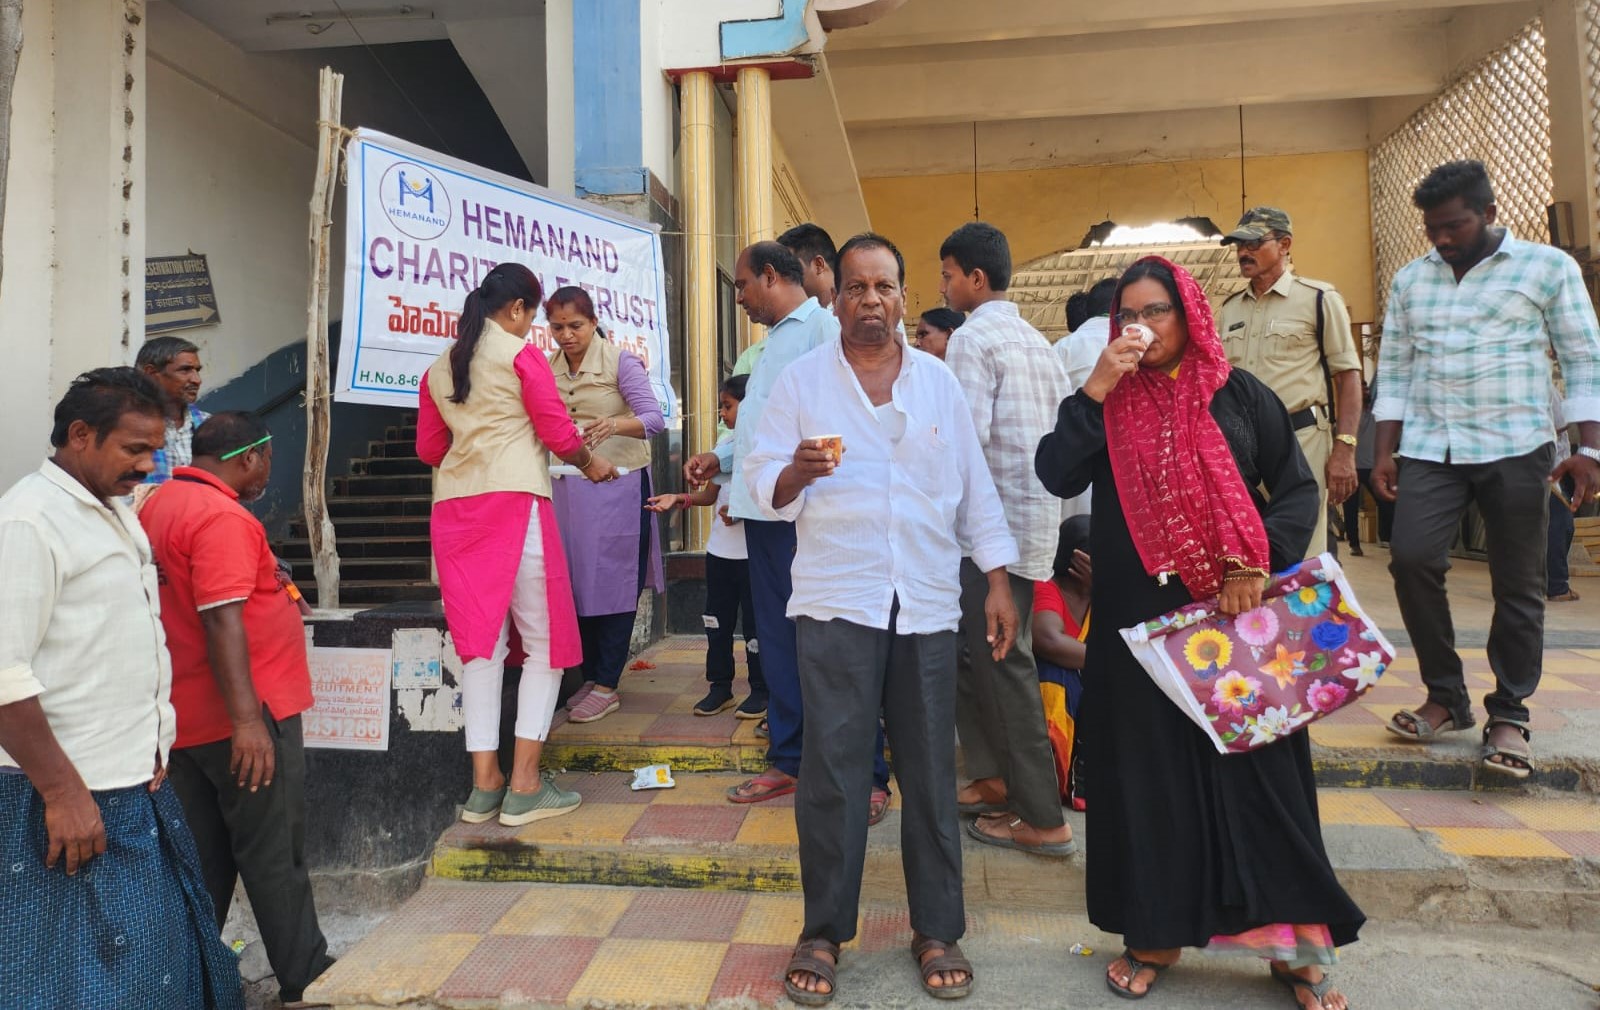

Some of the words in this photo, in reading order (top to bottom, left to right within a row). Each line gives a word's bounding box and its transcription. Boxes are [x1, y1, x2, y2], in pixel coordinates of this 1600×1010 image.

[388, 207, 446, 227] HEMANAND
[462, 199, 620, 274] HEMANAND
[184, 259, 206, 273] OFFICE
